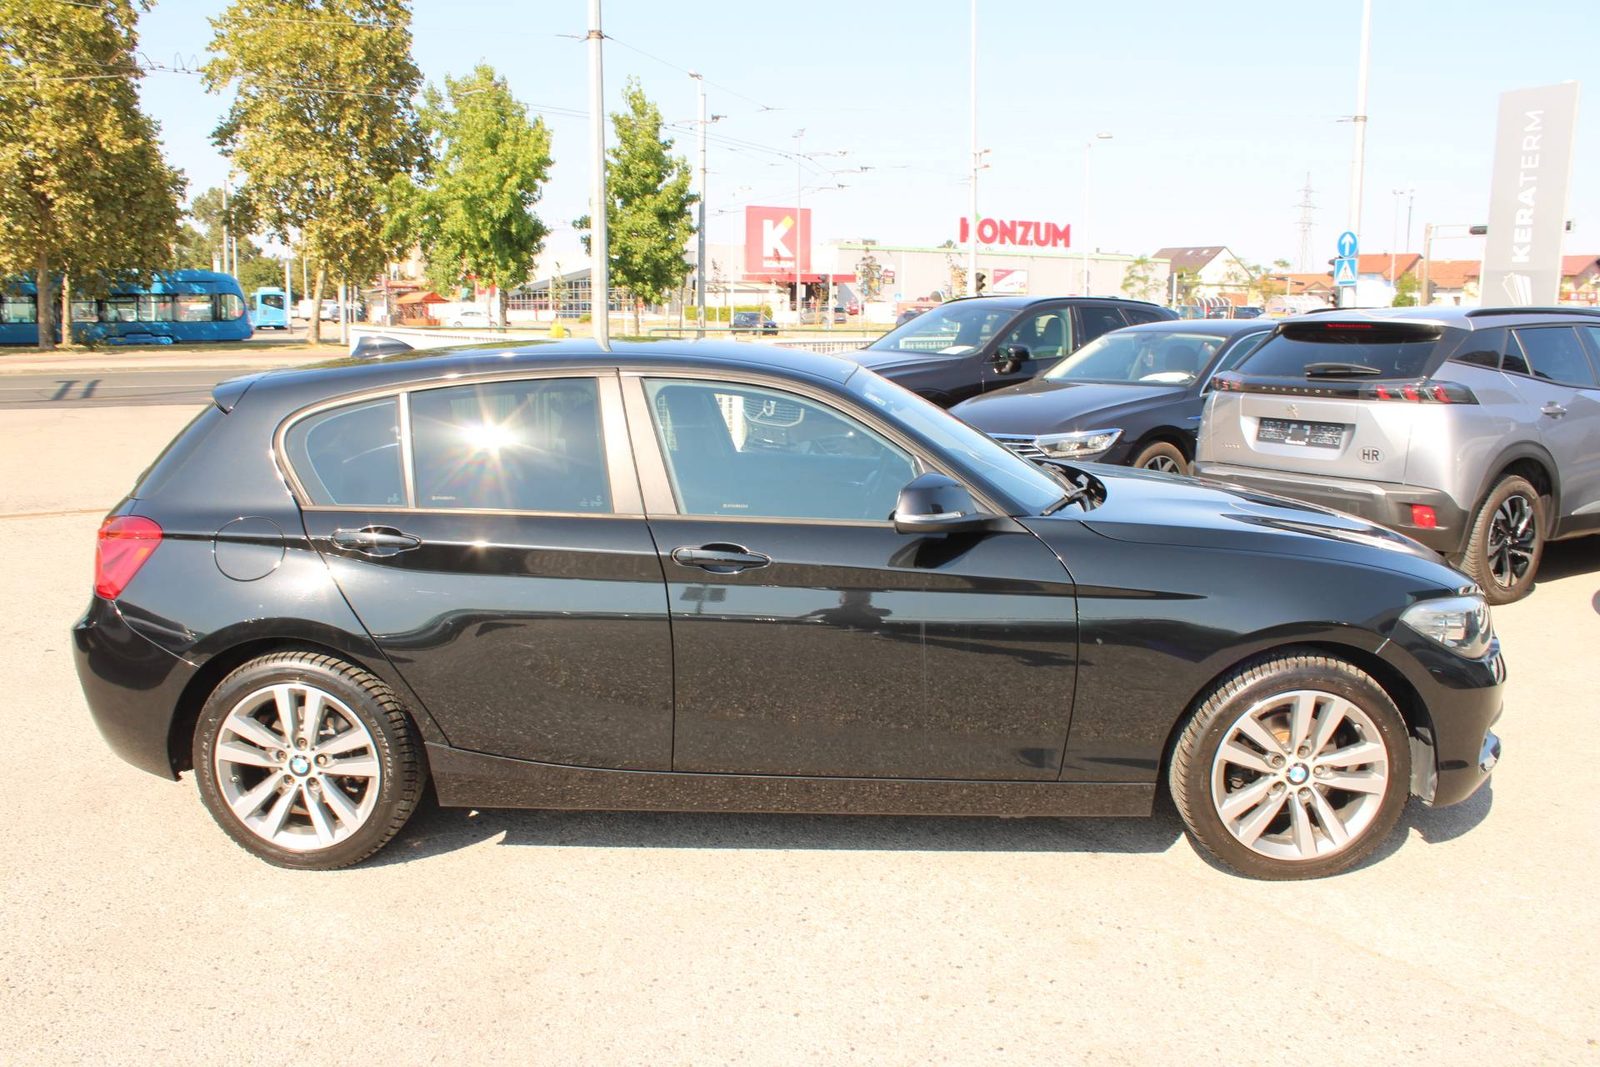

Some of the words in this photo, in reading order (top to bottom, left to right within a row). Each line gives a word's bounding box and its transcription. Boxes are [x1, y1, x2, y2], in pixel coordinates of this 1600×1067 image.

[1511, 109, 1545, 263] KERATERM
[762, 215, 795, 258] K
[1362, 448, 1380, 461] HR
